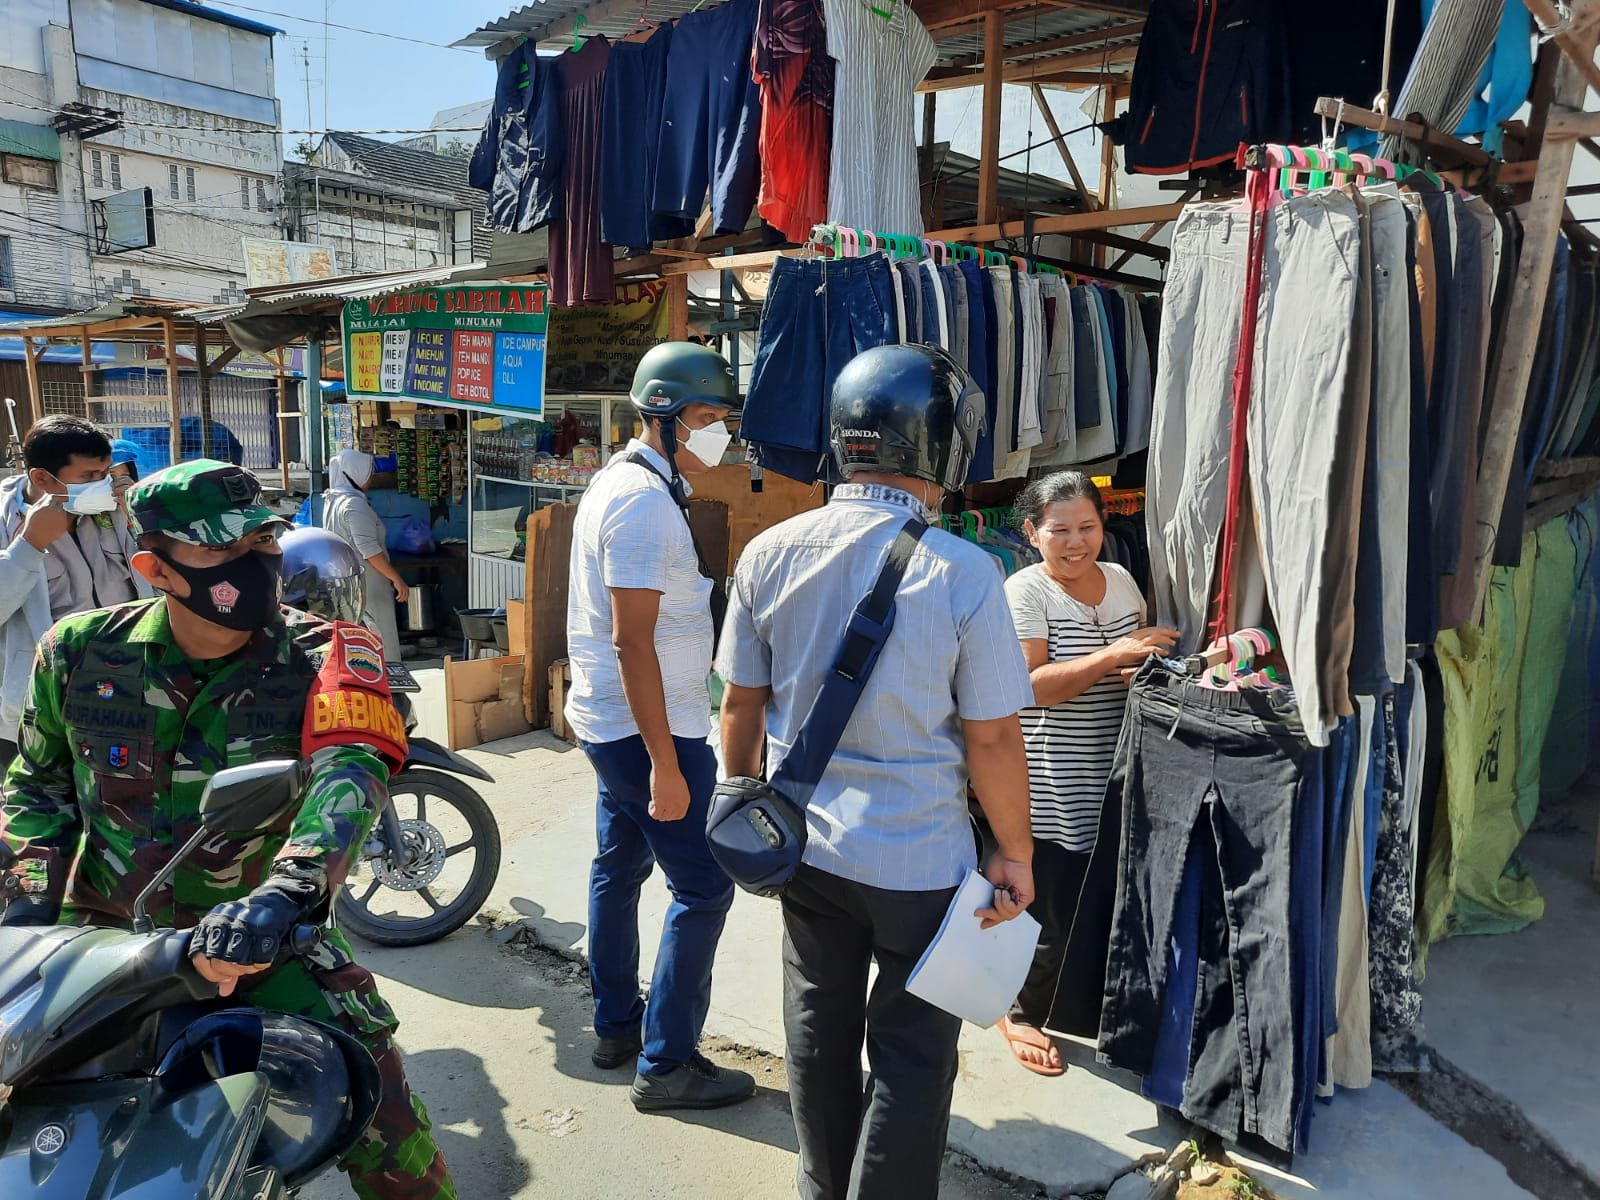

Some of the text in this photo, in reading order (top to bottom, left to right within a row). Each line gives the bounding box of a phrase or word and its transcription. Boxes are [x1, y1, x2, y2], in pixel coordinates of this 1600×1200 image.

[444, 289, 544, 315] SABILAH
[454, 317, 502, 327] MINUMAN
[432, 334, 444, 346] MIE
[459, 335, 471, 346] TEH
[458, 351, 470, 363] TEH
[502, 354, 523, 368] AQUA
[414, 363, 429, 376] MIE
[457, 368, 481, 380] POP ICE
[502, 371, 516, 385] DLL
[414, 379, 444, 393] INDOMIE
[456, 383, 490, 399] TEH BOTOL
[841, 429, 881, 439] HONDA
[217, 605, 231, 613] TNI
